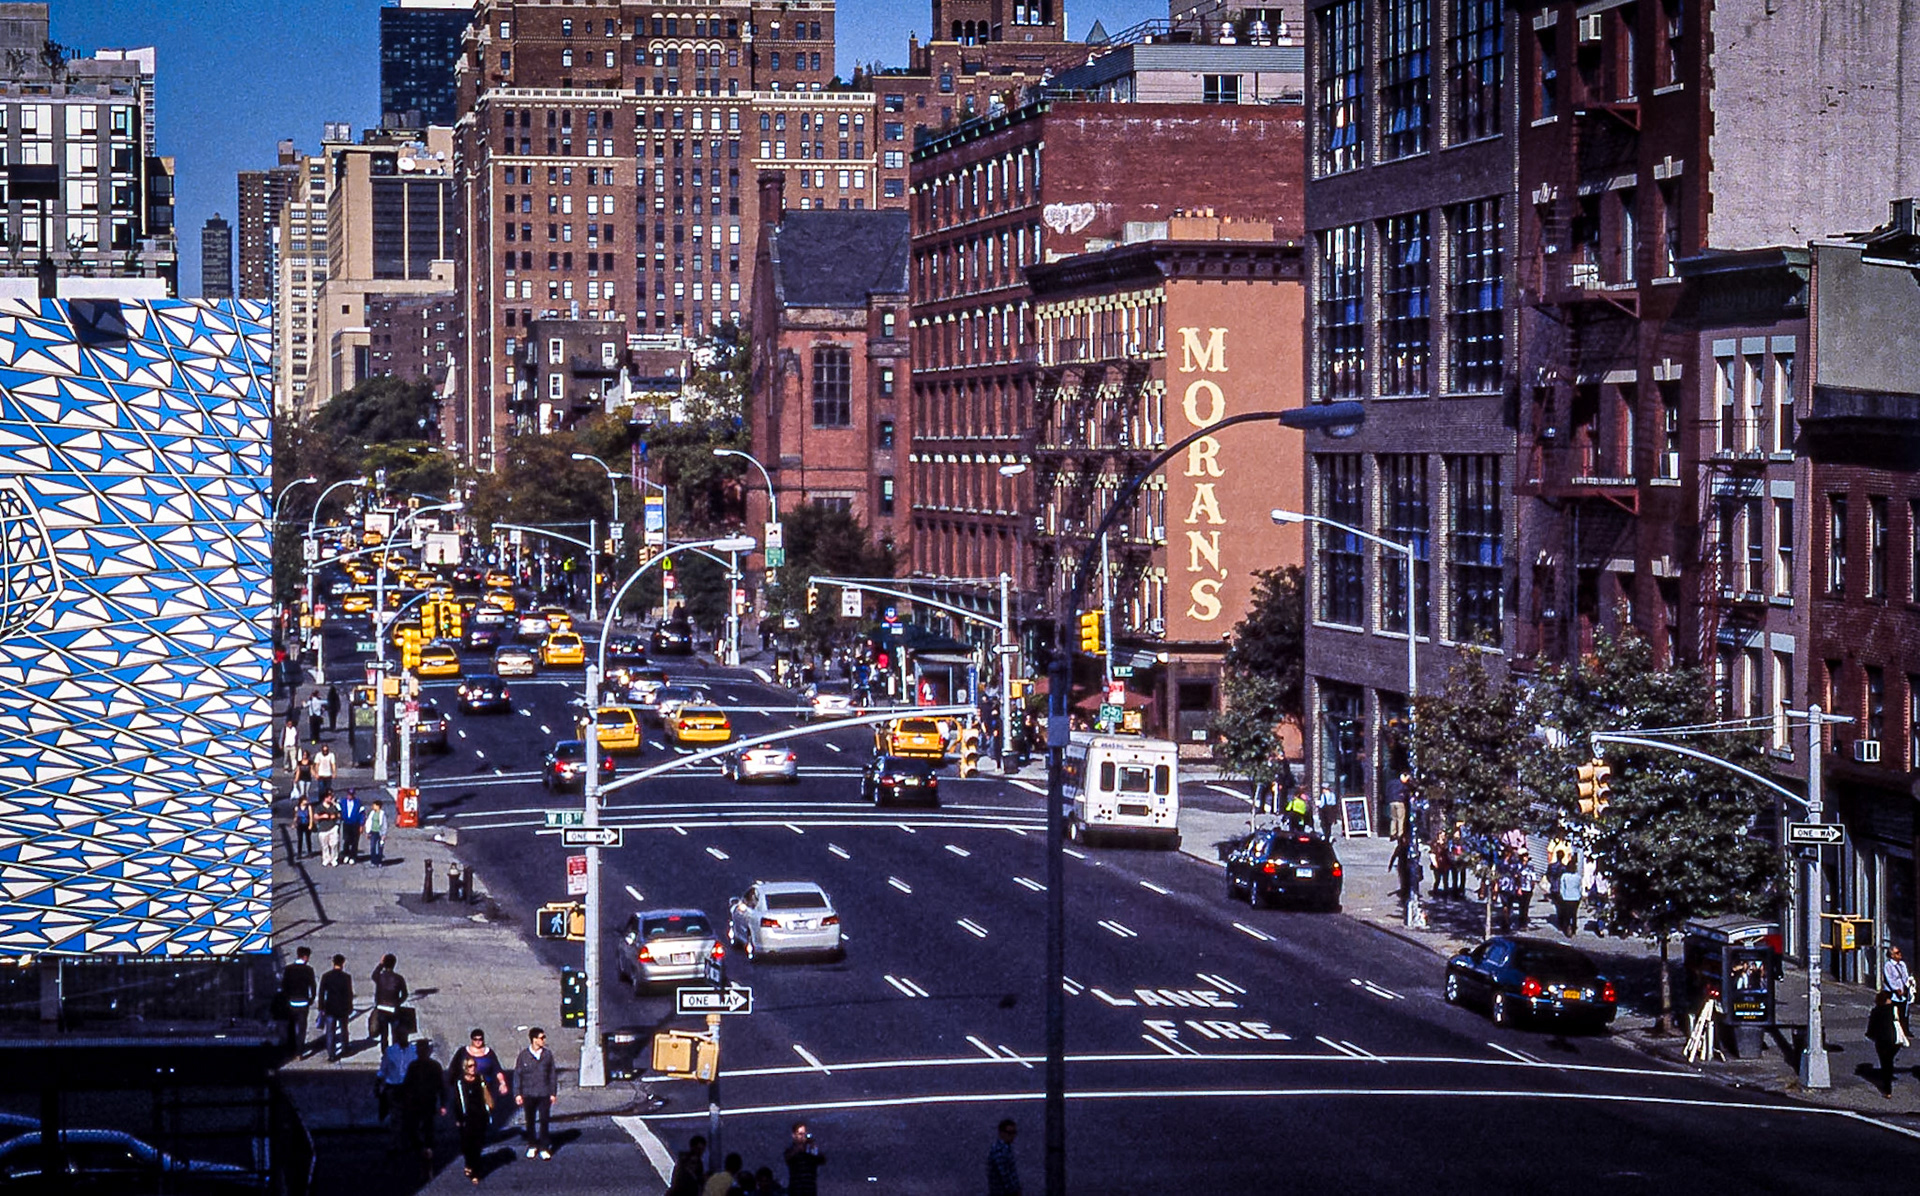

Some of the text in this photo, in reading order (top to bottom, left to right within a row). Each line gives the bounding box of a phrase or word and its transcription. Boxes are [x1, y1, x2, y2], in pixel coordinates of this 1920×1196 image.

[1177, 326, 1229, 622] MORAN'S
[547, 812, 557, 824] W
[571, 832, 612, 841] ONE WAY
[1797, 829, 1836, 838] ONE WAY
[688, 995, 709, 1006] ONE
[1090, 988, 1239, 1008] LANE
[1142, 1019, 1293, 1041] FIRE
